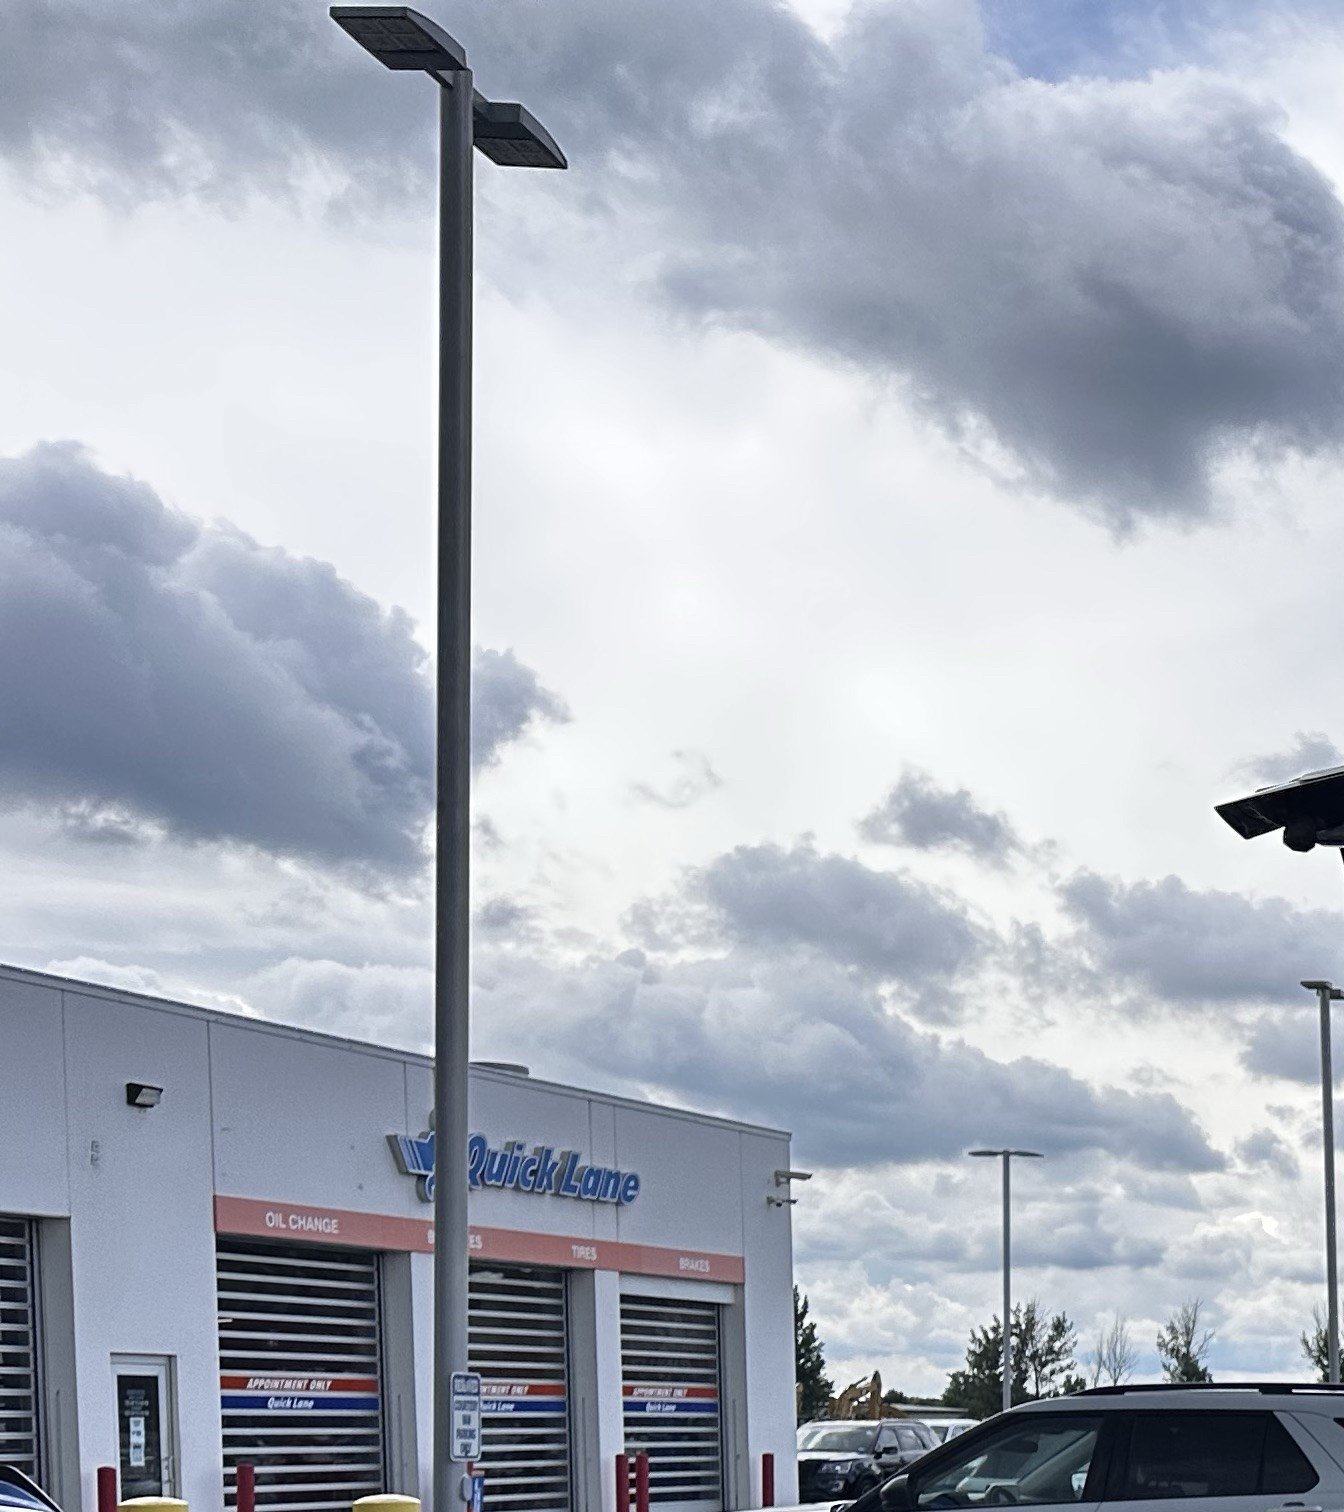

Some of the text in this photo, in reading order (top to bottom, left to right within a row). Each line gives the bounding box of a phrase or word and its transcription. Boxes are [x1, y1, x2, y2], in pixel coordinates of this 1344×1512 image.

[559, 1150, 641, 1206] Lane
[265, 1211, 340, 1234] OIL CHANGE
[571, 1244, 597, 1261] TIRES
[679, 1257, 711, 1273] BRAKES
[246, 1377, 333, 1391] APPOINTMENT ONLY
[267, 1397, 314, 1410] Quick Lane
